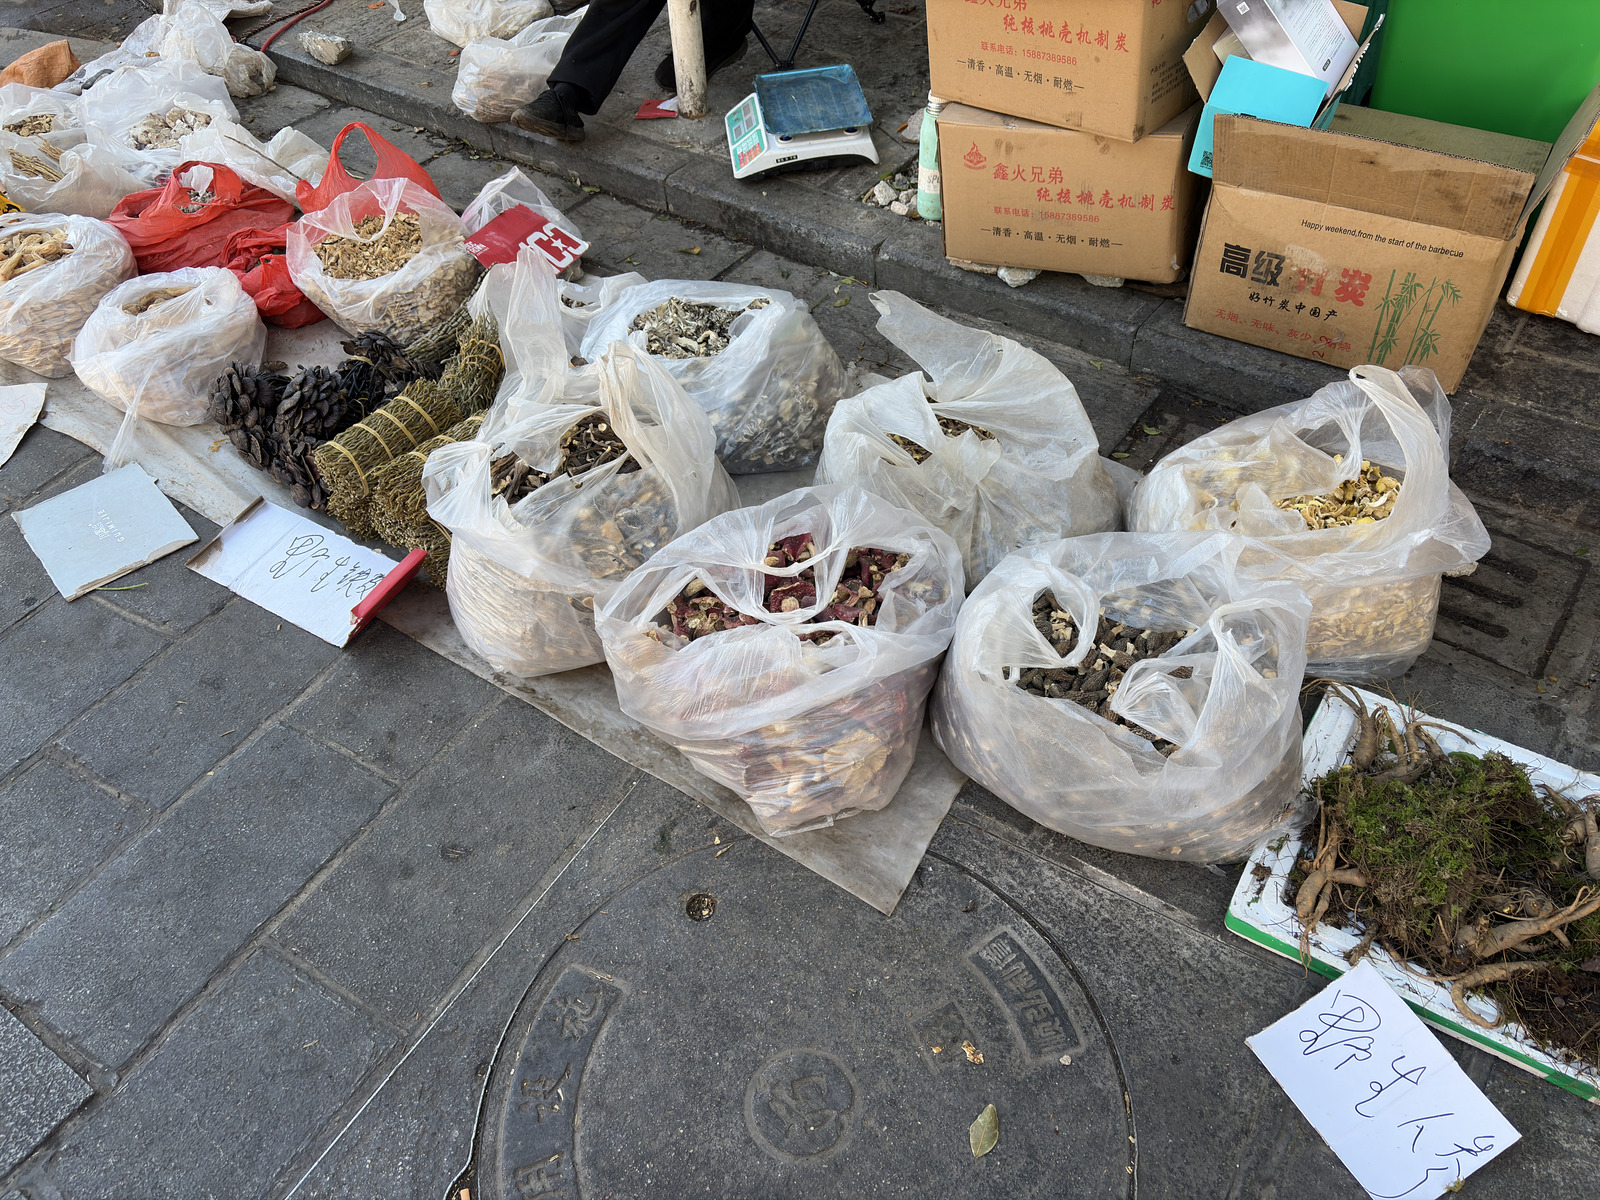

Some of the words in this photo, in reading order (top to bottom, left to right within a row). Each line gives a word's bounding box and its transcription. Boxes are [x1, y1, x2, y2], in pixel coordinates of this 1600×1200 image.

[1003, 13, 1130, 53] 纯核桃壳机制炭
[993, 162, 1064, 184] 鑫火兄弟
[1036, 187, 1176, 212] 纯核桃壳机制炭
[1301, 219, 1324, 232] Happy
[1375, 234, 1387, 244] the
[1388, 237, 1404, 247] start
[1405, 240, 1415, 249] of
[1415, 242, 1427, 252] the
[1428, 245, 1464, 258] barbecue
